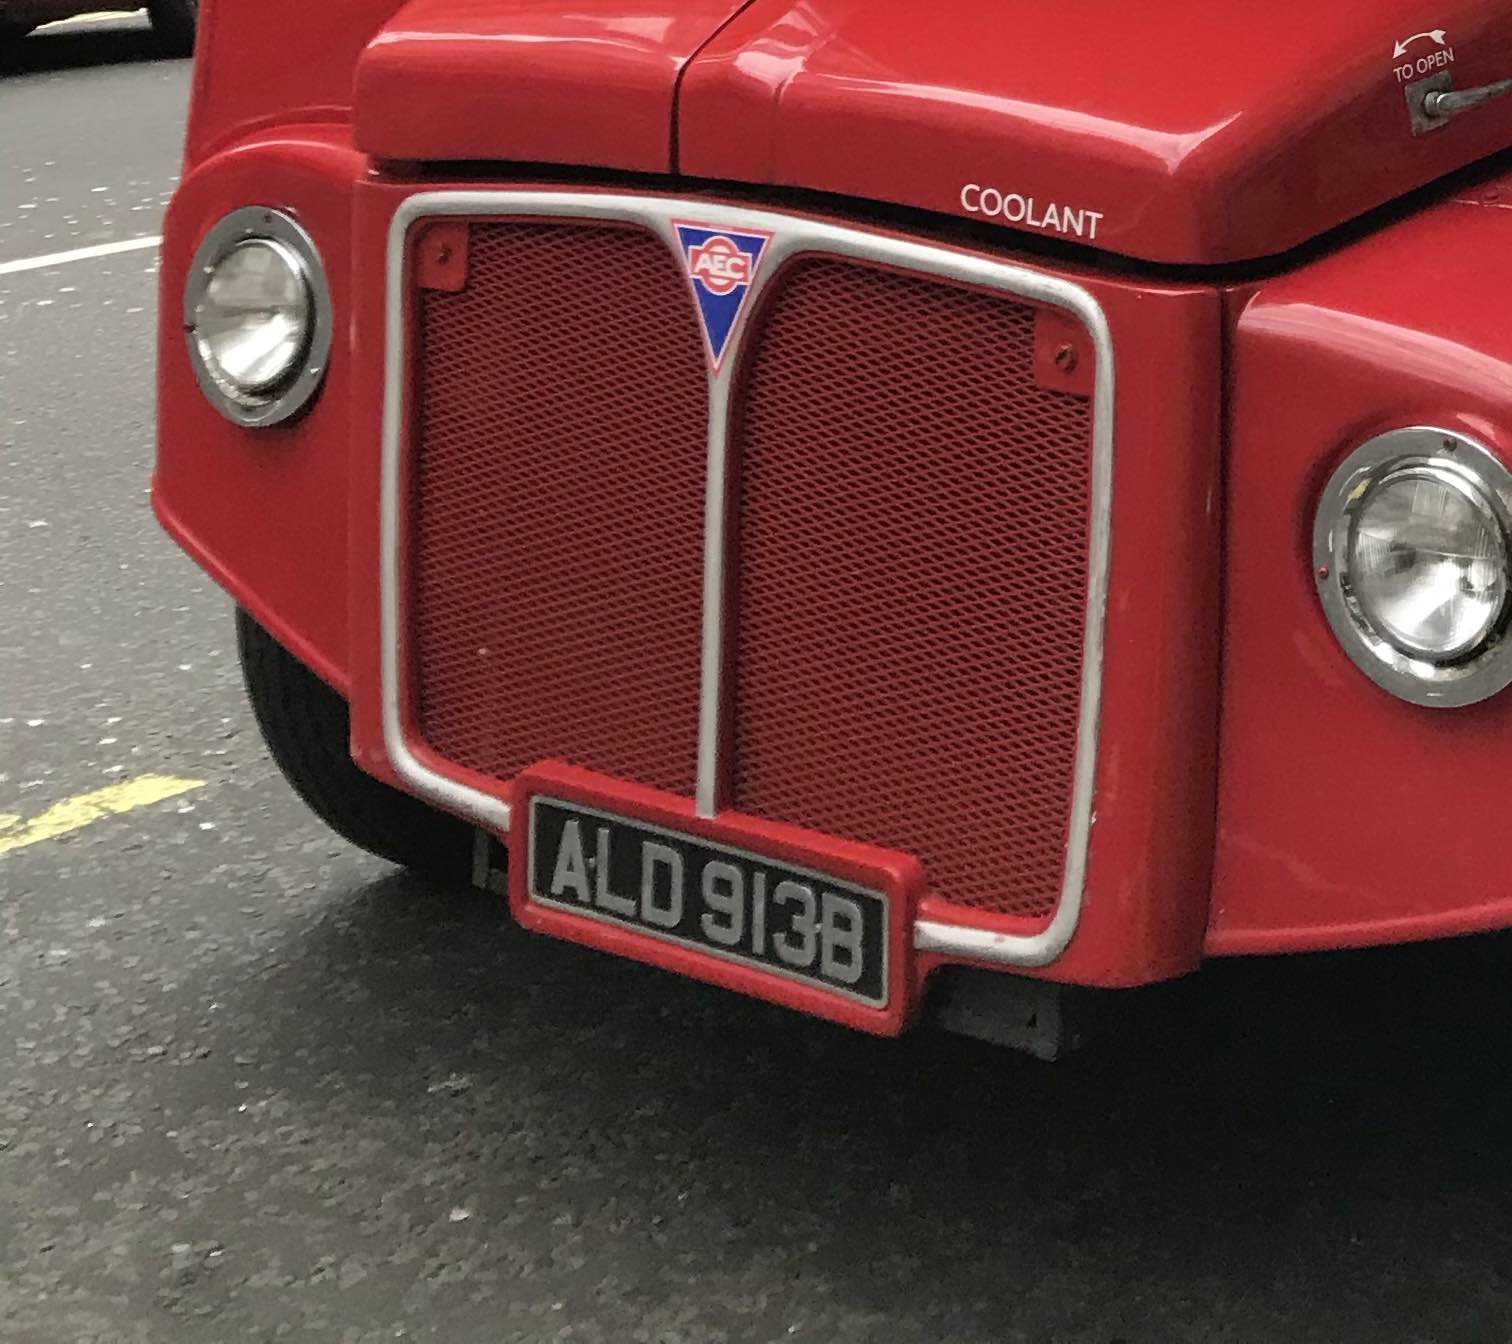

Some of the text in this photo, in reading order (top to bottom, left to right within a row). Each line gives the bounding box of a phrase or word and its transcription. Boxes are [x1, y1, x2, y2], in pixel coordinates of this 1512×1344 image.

[1392, 47, 1455, 83] TO OPEN
[960, 184, 1104, 242] COOLANT
[692, 253, 746, 280] AEC
[551, 819, 865, 985] ALD 913B
